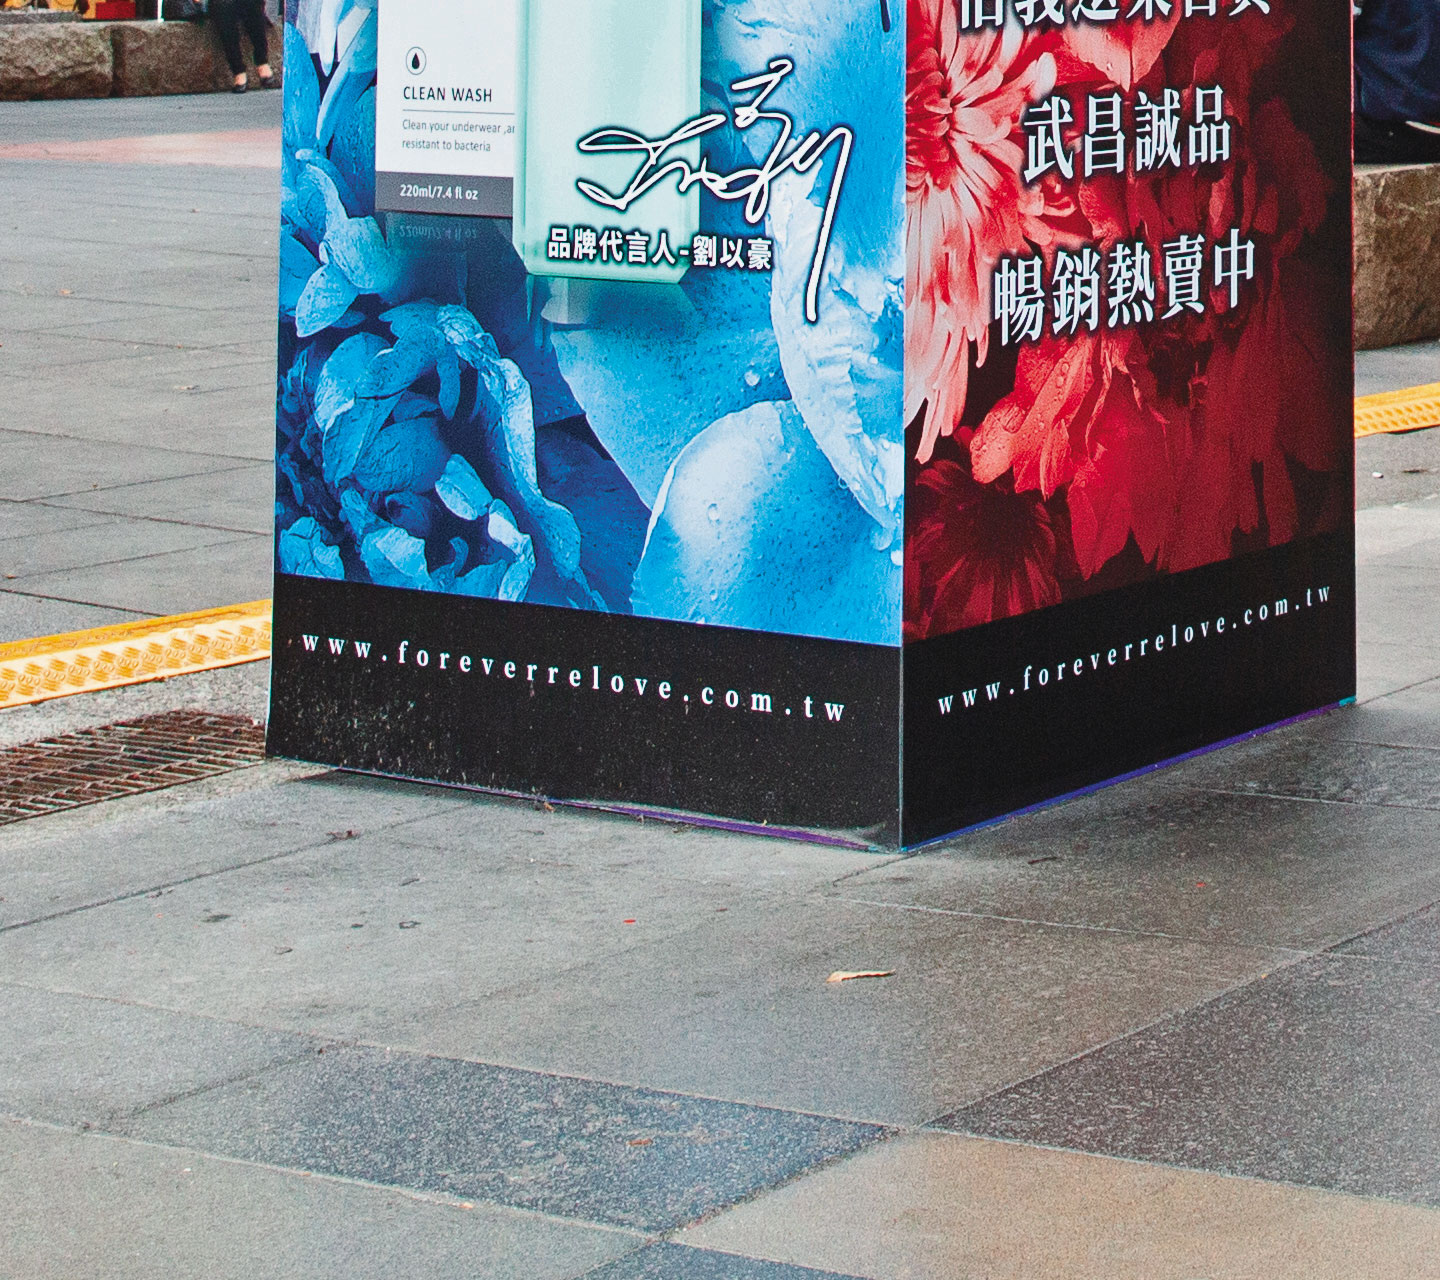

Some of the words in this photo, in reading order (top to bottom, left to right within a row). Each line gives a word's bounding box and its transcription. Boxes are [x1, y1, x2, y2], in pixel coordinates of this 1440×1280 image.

[403, 86, 445, 101] CLEAN
[452, 87, 493, 102] WASH
[402, 118, 427, 130] Clean
[452, 122, 500, 134] underwear
[1023, 84, 1231, 184] 武昌誠品
[442, 140, 452, 150] to
[454, 140, 491, 152] bacteria
[465, 190, 478, 200] oz
[547, 227, 772, 271] 品牌代言人-劉以豪
[993, 228, 1256, 346] 暢銷熱賣中
